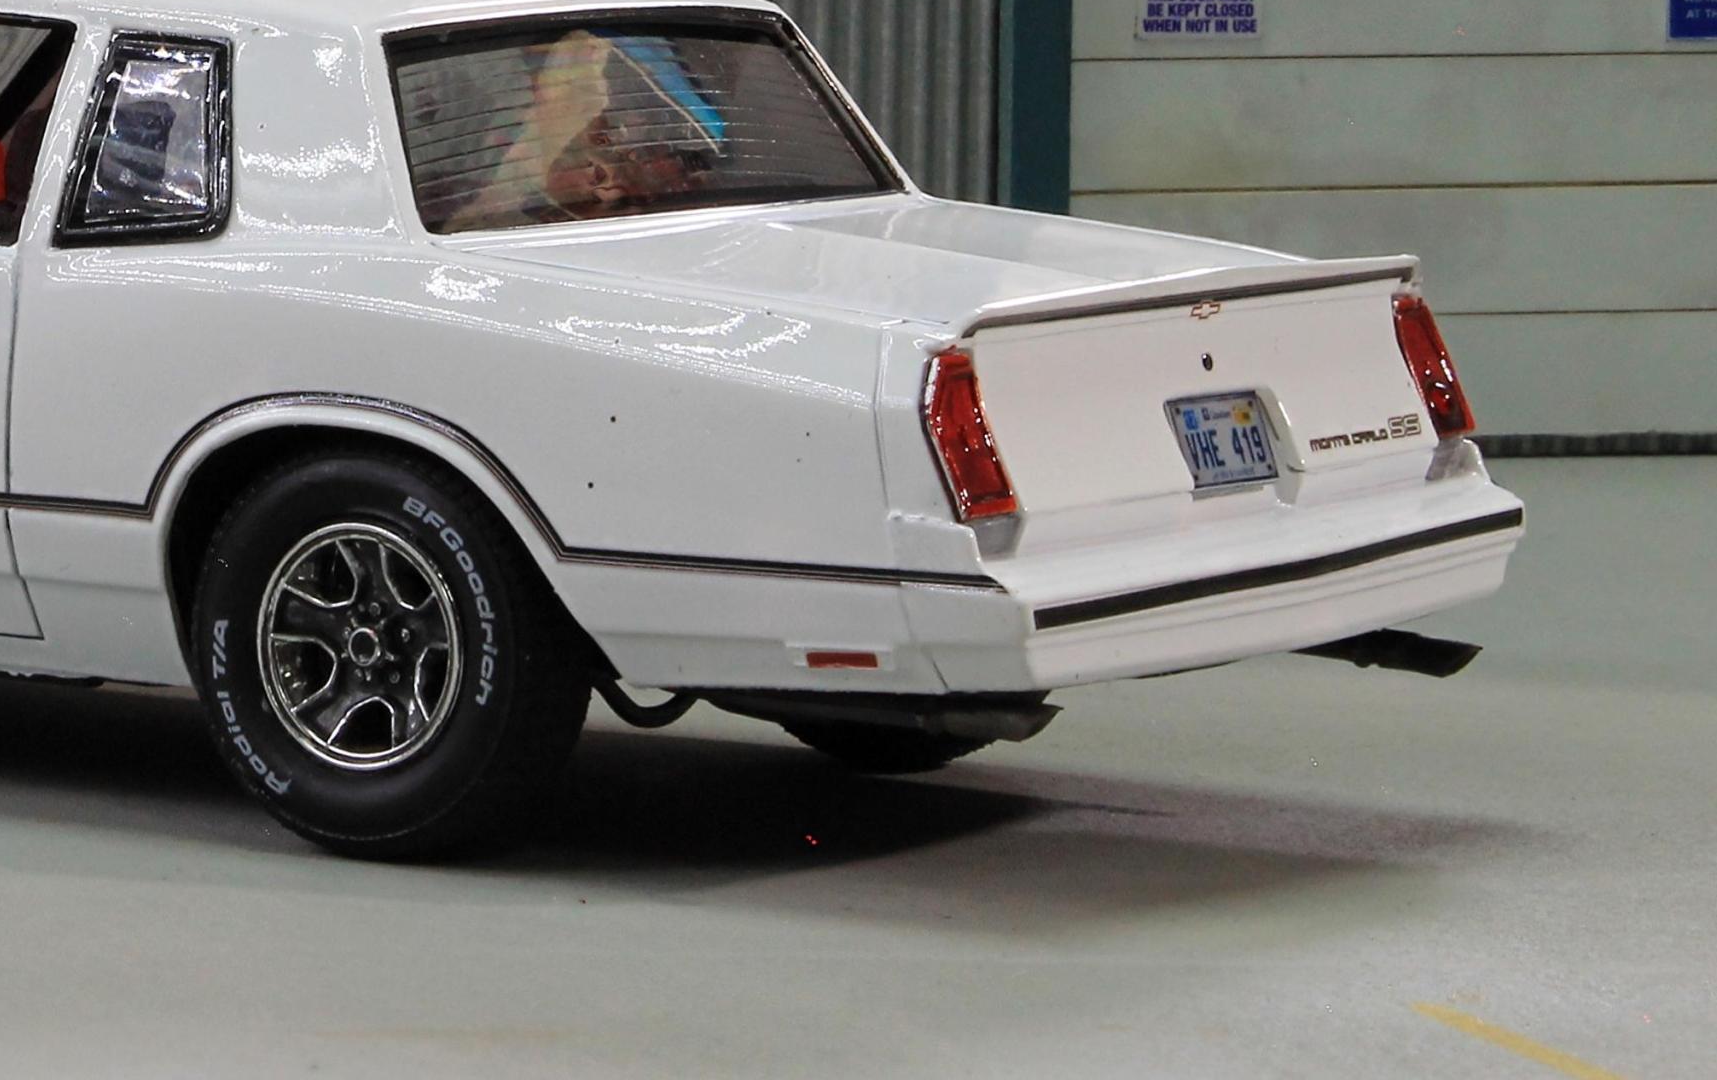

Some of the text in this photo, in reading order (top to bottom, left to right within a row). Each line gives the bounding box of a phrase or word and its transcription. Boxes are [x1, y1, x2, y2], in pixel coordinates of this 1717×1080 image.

[1147, 3, 1254, 17] BE KEPT CLOSED
[1143, 19, 1257, 33] WHEN NOT IN USE
[1388, 413, 1422, 439] SS
[1185, 426, 1267, 471] VHE 419
